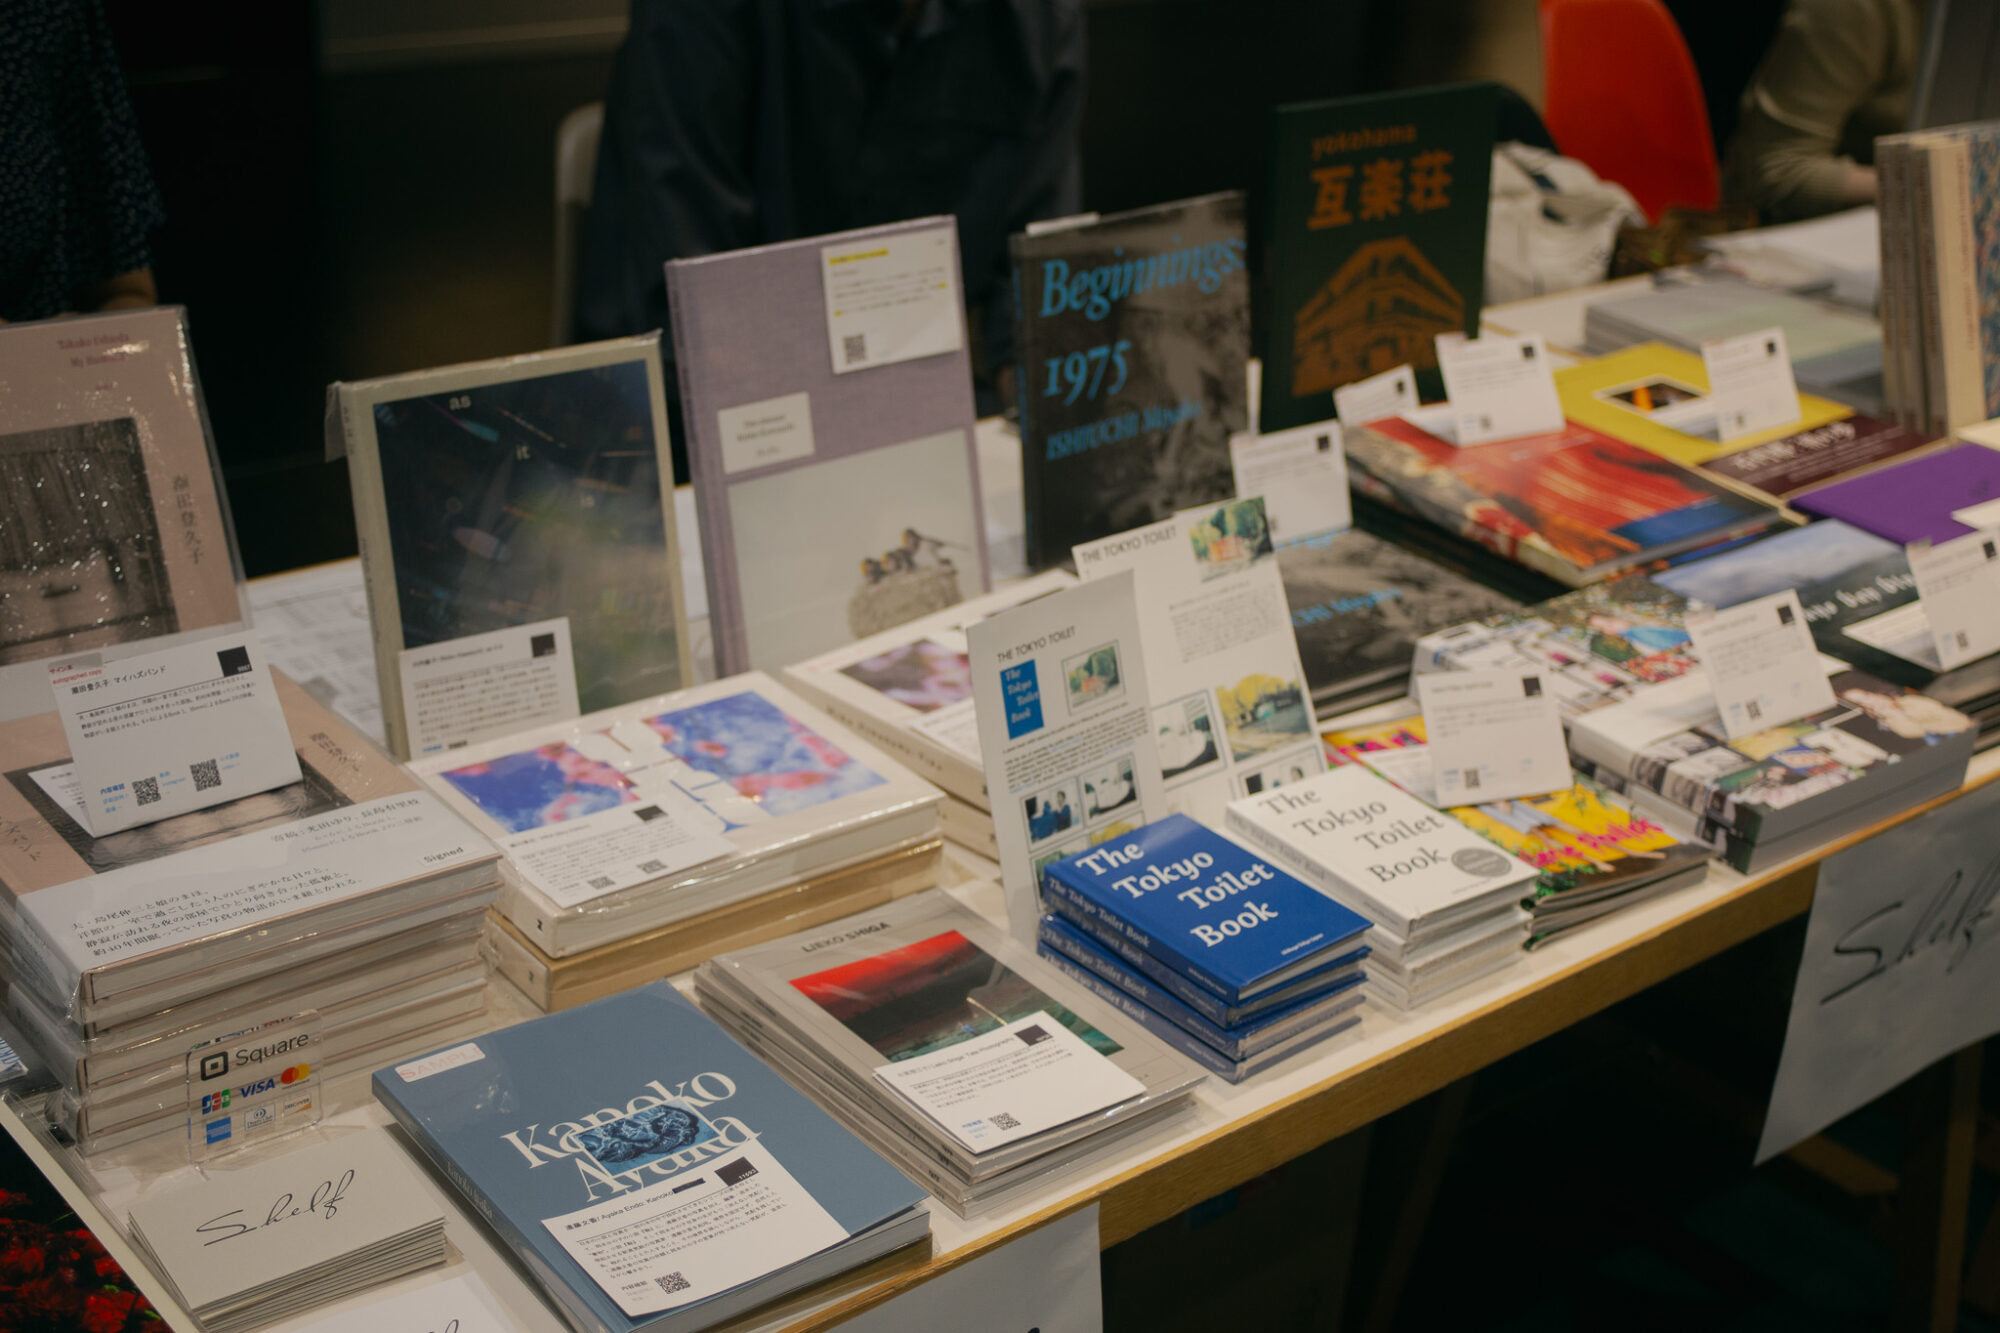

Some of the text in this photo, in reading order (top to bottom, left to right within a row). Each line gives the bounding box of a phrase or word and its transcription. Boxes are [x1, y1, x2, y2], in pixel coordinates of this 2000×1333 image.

[1307, 150, 1453, 231] 互楽荘
[1043, 340, 1131, 406] 1975
[1081, 525, 1176, 565] THE TOKYO TOILET
[997, 625, 1075, 662] THE TOKYO TOILET
[114, 664, 168, 683] マイハズバンド
[1258, 788, 1322, 816] The
[1292, 800, 1388, 837] Tokyo
[1353, 814, 1445, 850] Toilet
[423, 846, 465, 864] Signed
[1075, 840, 1145, 877] The
[1367, 846, 1449, 883] Book
[1111, 849, 1215, 899] Tokyo
[1177, 861, 1277, 912] Toilet
[1049, 877, 1150, 947] The Tokyo Toilet Book
[1189, 899, 1279, 949] Book
[801, 922, 891, 953] LIEKO SHIGA
[1123, 974, 1149, 998] Book
[1122, 998, 1147, 1022] Book
[236, 1033, 309, 1066] Square
[201, 1088, 231, 1115] JCB
[240, 1078, 276, 1098] VISA
[501, 1072, 737, 1168] Kanoko
[575, 1116, 762, 1203] Aya
[196, 1169, 356, 1247] Shelf
[601, 1206, 625, 1220] Ayaka
